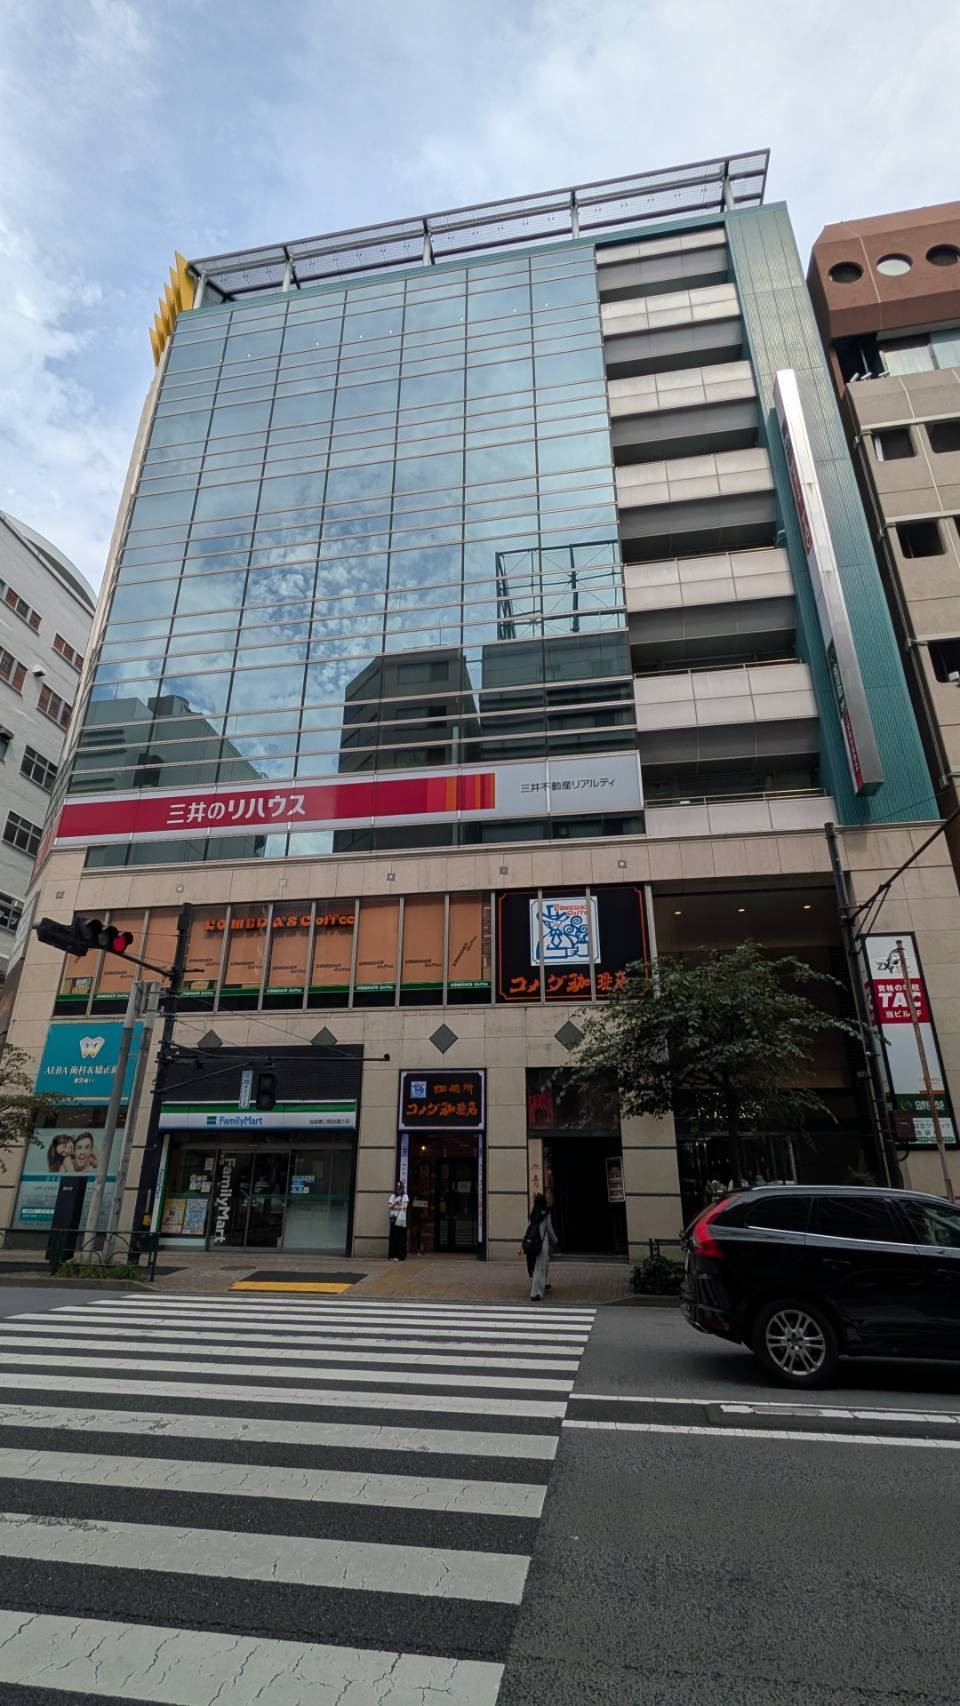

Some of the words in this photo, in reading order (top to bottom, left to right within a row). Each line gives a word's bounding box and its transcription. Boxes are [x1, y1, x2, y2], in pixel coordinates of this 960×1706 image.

[521, 777, 616, 793] 三井不動産リアルティ
[167, 794, 306, 824] 三井のリハウス
[878, 992, 922, 1008] TAC
[885, 1009, 922, 1018] 当ビルF
[219, 1115, 263, 1127] FamilyMart
[214, 1157, 236, 1244] FamilyMart
